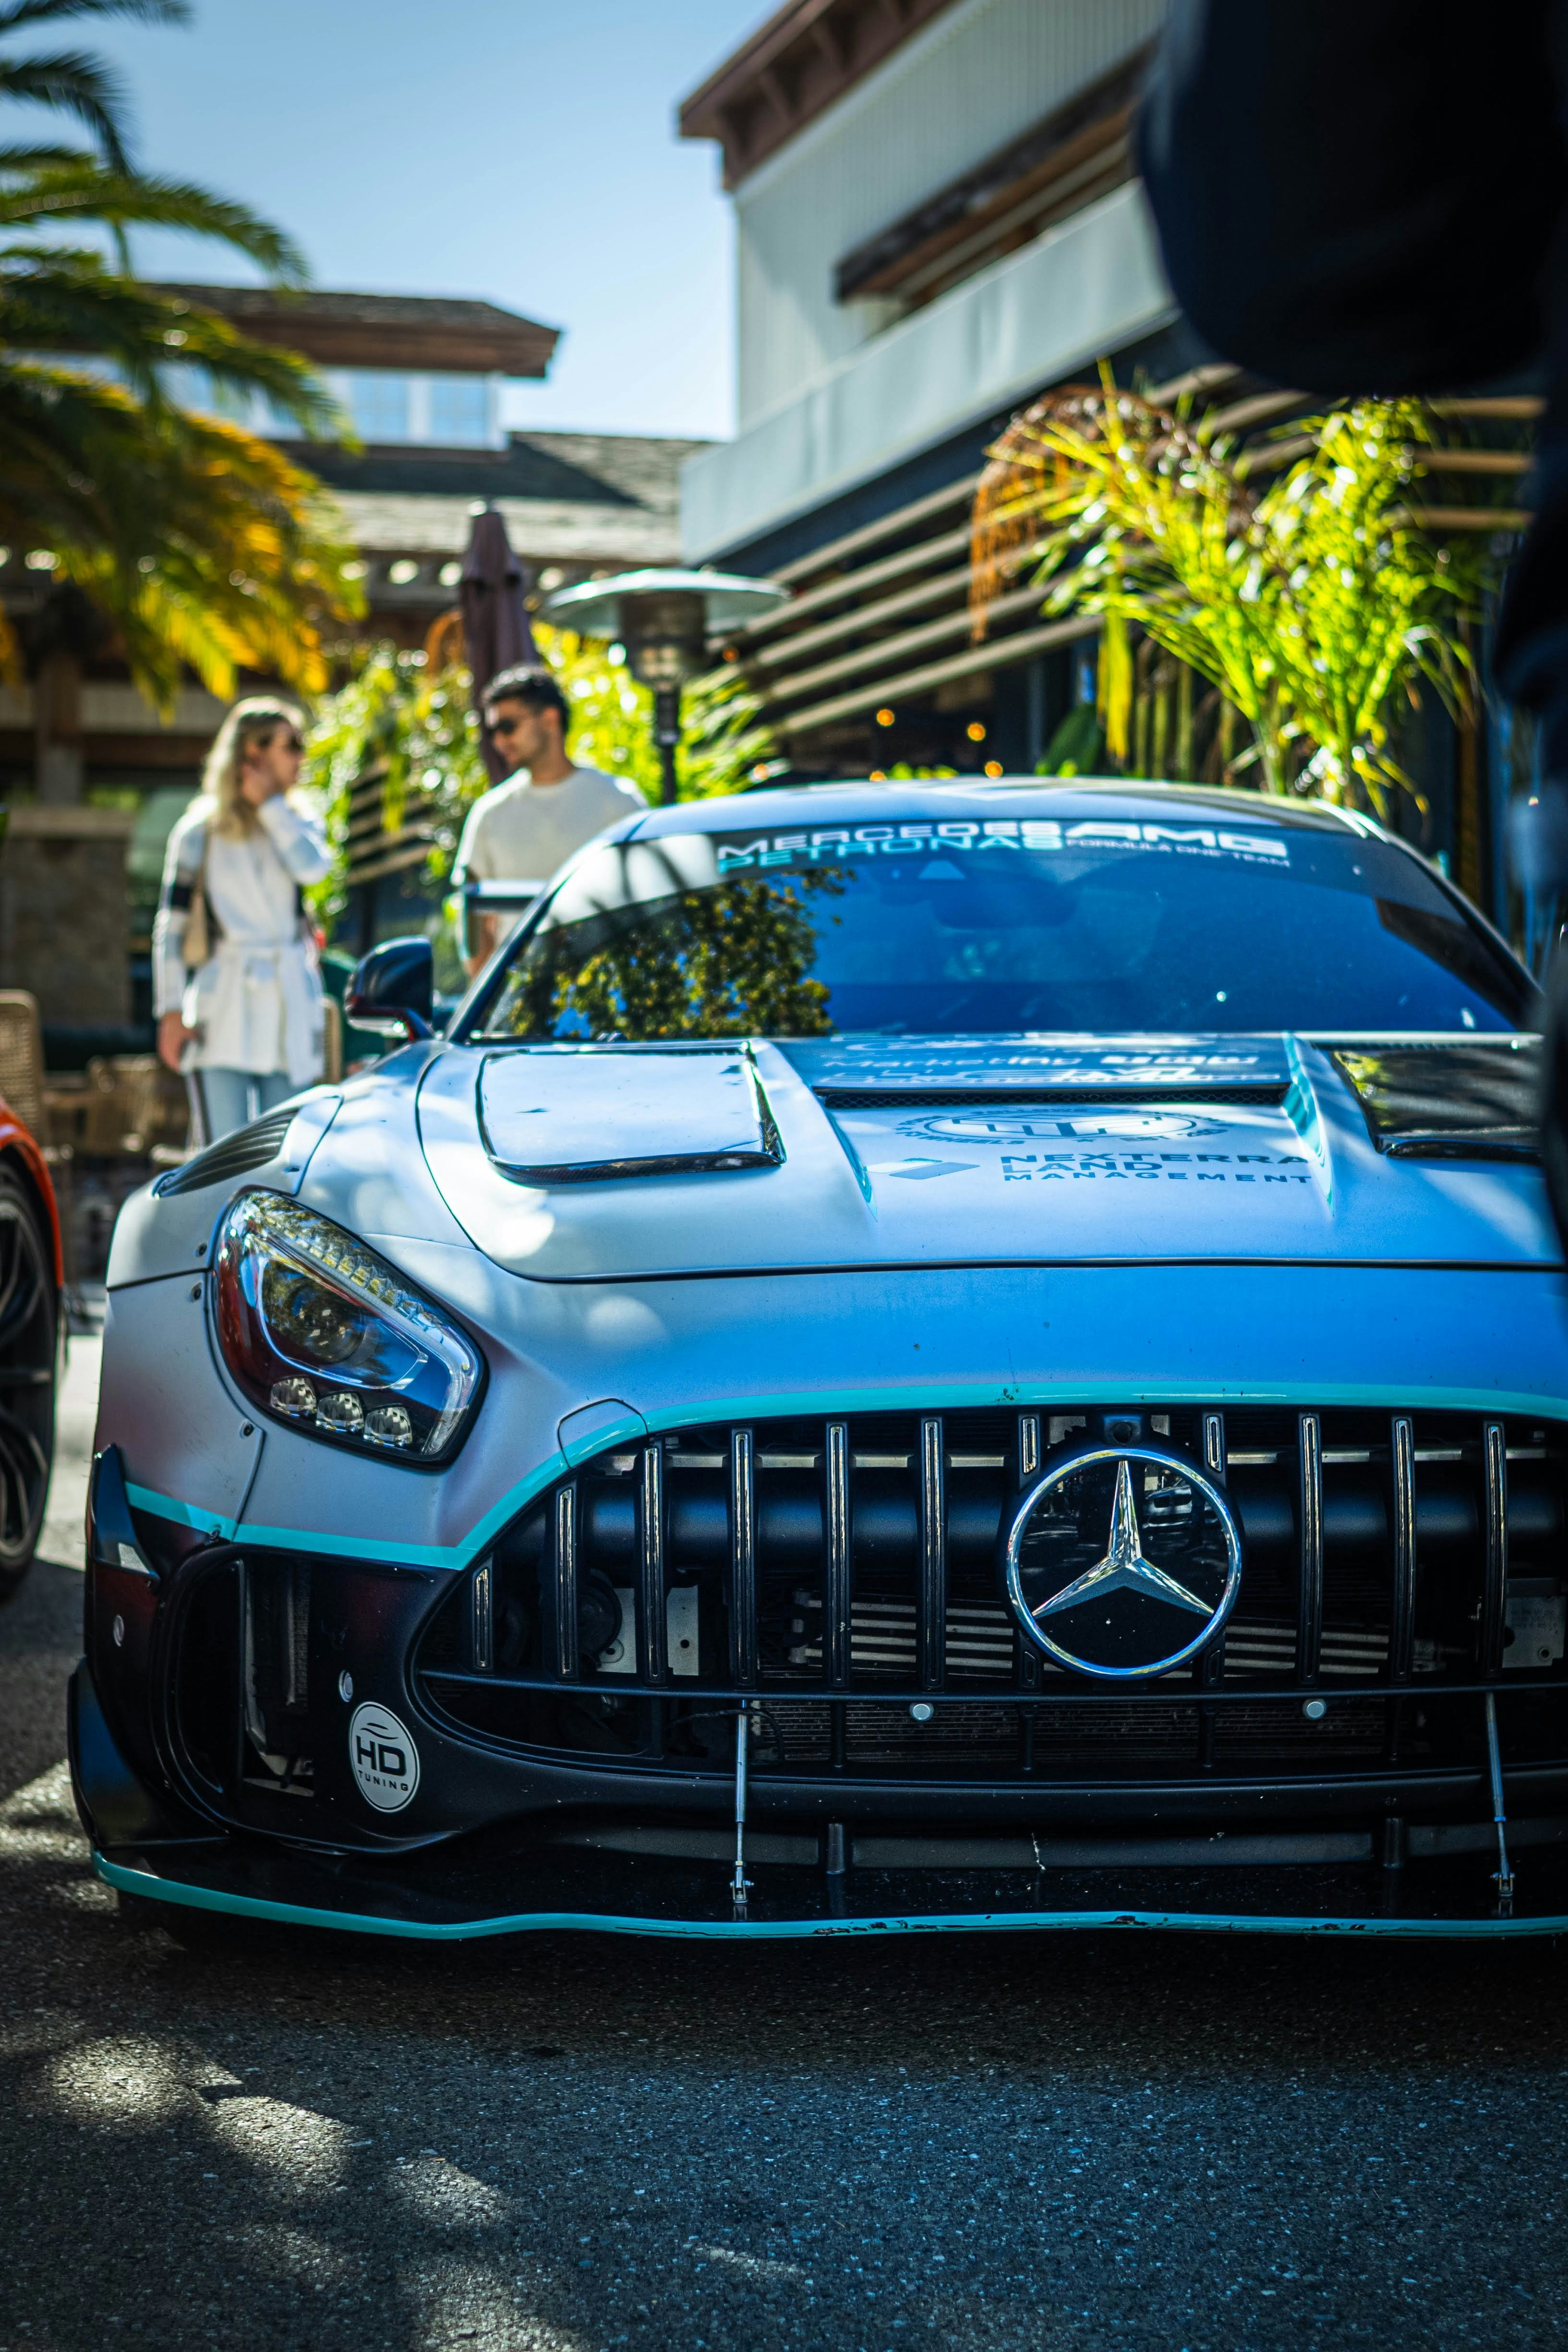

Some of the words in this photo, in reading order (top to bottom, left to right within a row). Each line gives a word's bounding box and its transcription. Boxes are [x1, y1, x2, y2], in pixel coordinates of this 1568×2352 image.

[718, 821, 1061, 858] MERCEDES
[1065, 821, 1288, 857] AMG
[719, 835, 1064, 874] PETRONAS
[1066, 840, 1171, 853] FORMULA
[1175, 845, 1221, 857] ONE
[1231, 852, 1291, 868] TEAM
[823, 1056, 1083, 1067] Marketing
[917, 1135, 1026, 1145] WHEELS
[1001, 1153, 1309, 1164] NEXTERRA
[1002, 1161, 1163, 1173] LAND
[1004, 1172, 1312, 1183] MANAGEMENT
[356, 1735, 407, 1777] HD
[357, 1770, 409, 1791] TUNING
